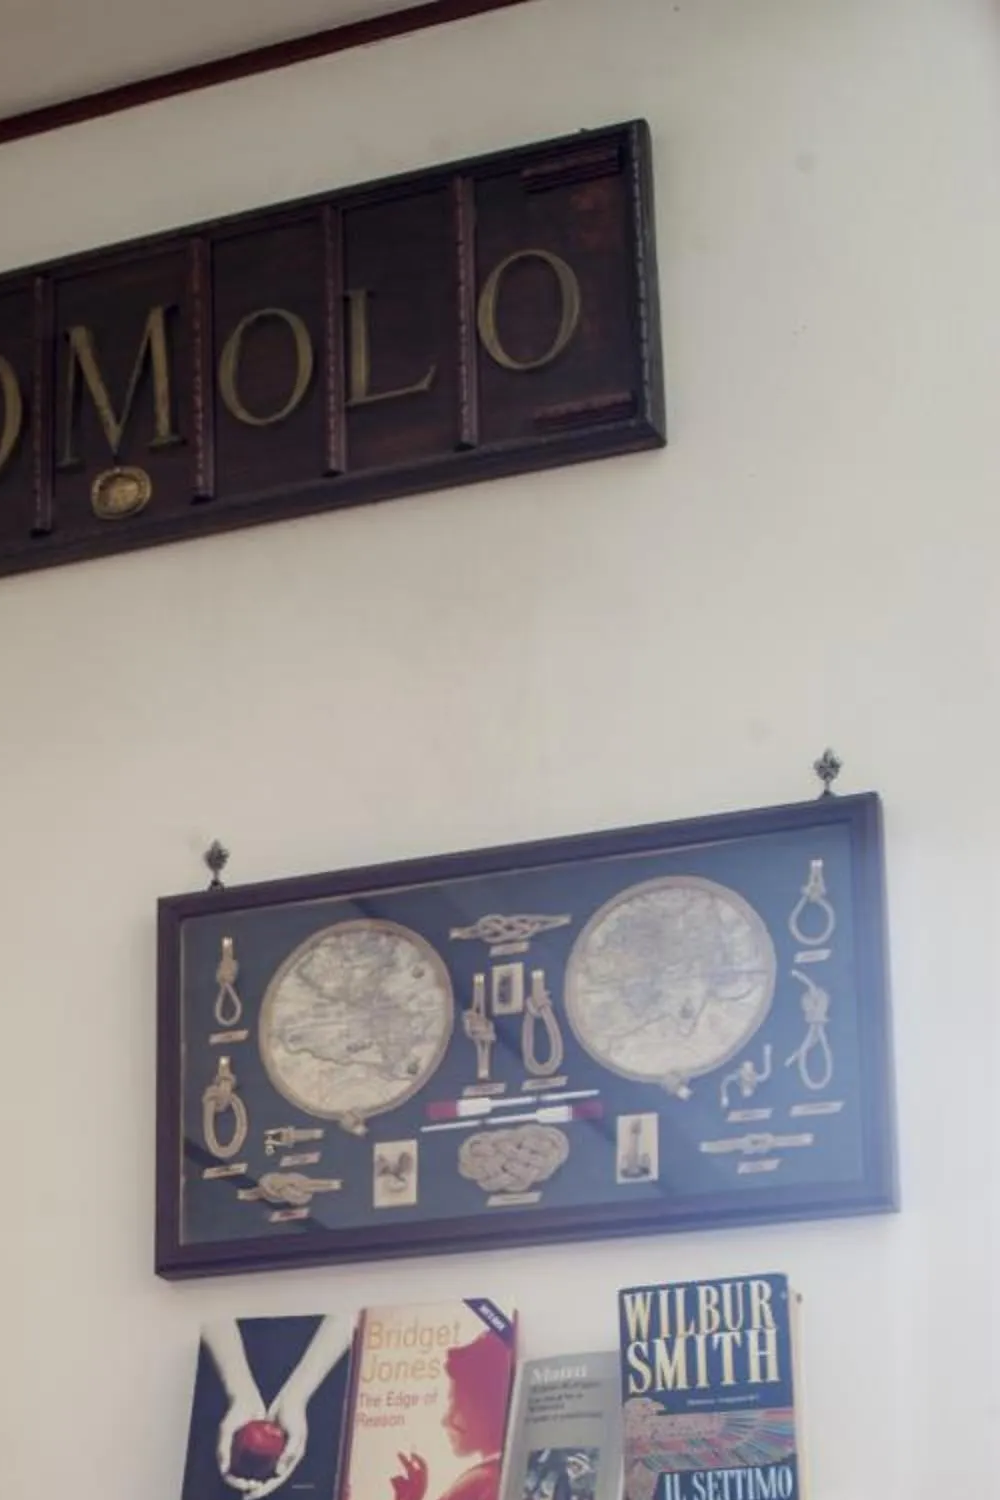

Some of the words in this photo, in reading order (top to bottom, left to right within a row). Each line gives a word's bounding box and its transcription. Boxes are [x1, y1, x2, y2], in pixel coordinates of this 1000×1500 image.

[367, 1316, 460, 1355] Bridget
[624, 1279, 777, 1342] WILBUR
[360, 1352, 441, 1383] Jones
[627, 1328, 779, 1393] SMITH
